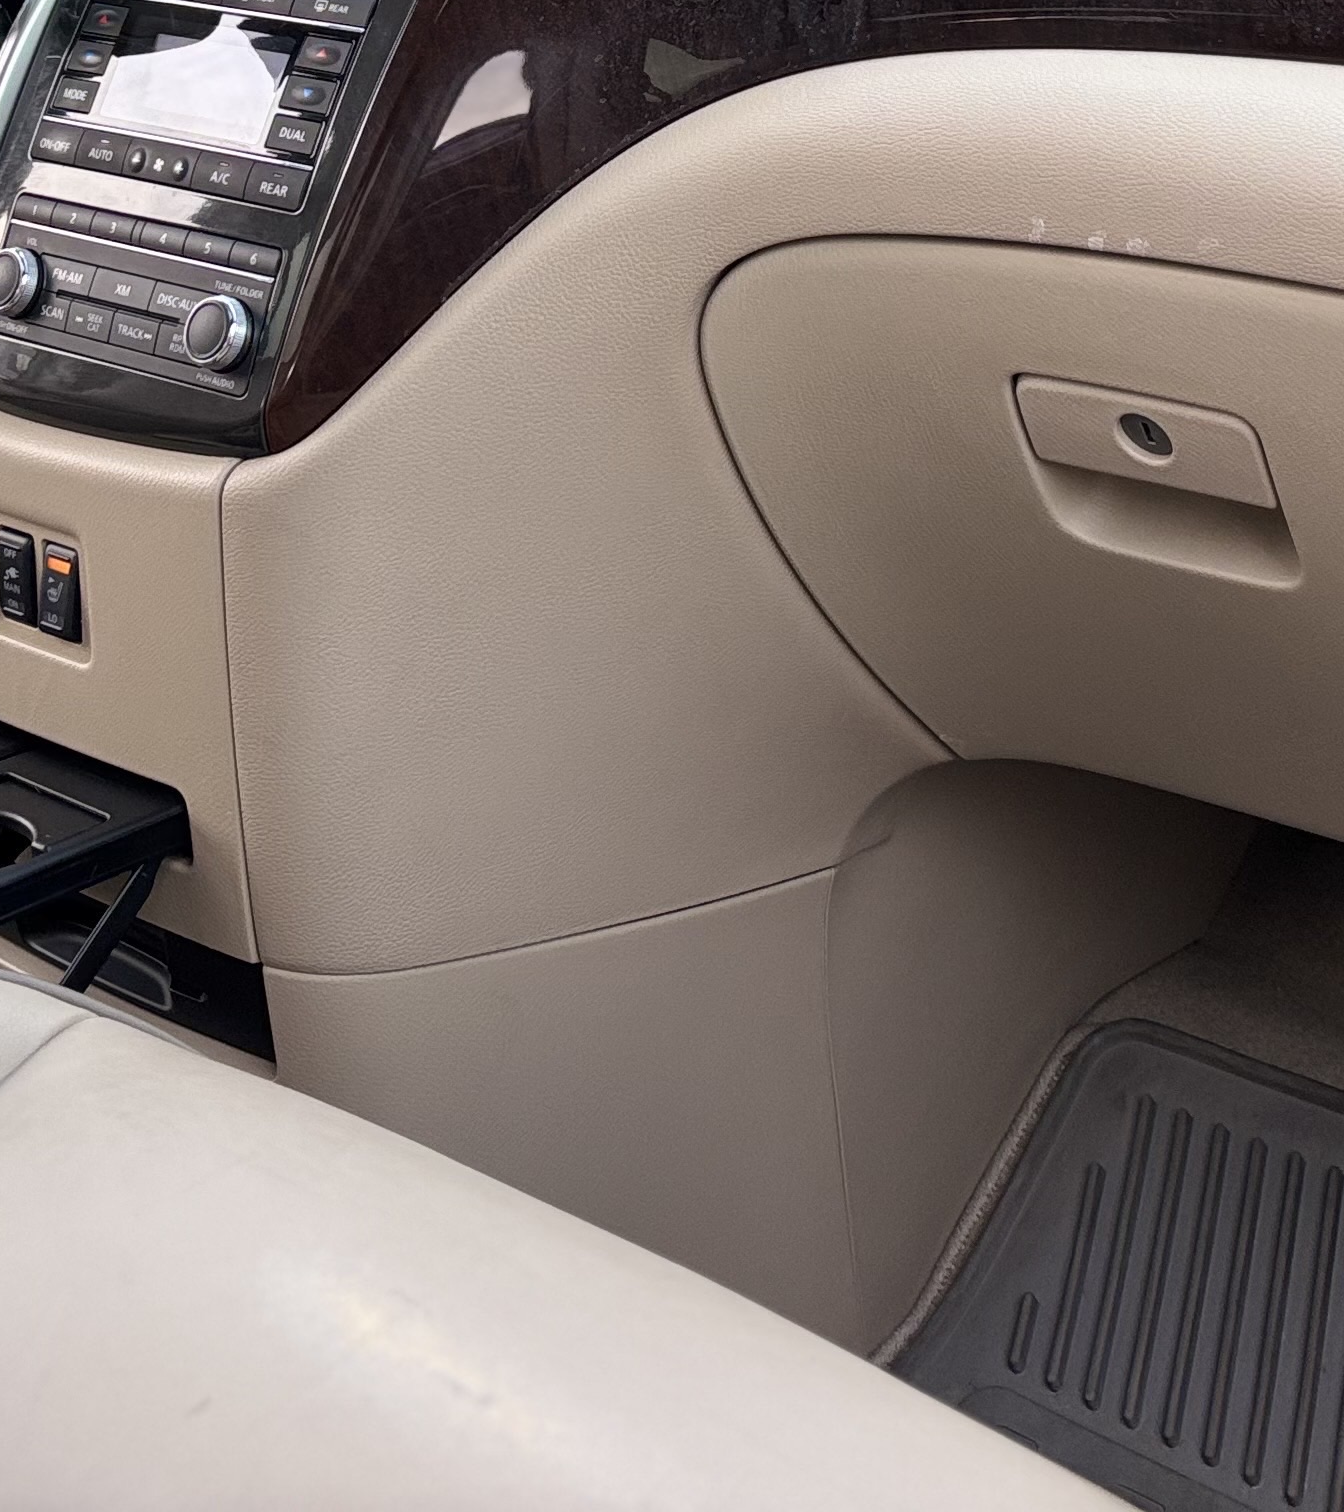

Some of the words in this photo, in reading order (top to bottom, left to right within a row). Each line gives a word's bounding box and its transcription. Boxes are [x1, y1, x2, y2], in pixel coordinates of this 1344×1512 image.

[328, 3, 350, 14] REAR
[62, 87, 89, 102] MODE
[278, 126, 307, 143] DUAL
[88, 147, 114, 162] AUTO
[209, 171, 231, 186] A/C
[259, 181, 289, 198] REAR
[31, 204, 38, 216] 1
[68, 212, 77, 225] 2
[109, 221, 118, 234] 3
[158, 232, 167, 245] 4
[203, 242, 212, 255] 5
[248, 252, 258, 266] 6
[113, 282, 132, 297] XM
[214, 279, 264, 300] TUNE/FOLDER
[40, 304, 65, 321] SCAN
[87, 312, 104, 325] SEEK
[86, 322, 101, 333] CAT
[118, 323, 143, 341] TRACK
[172, 333, 184, 343] RP
[210, 376, 236, 390] AUDIO
[3, 548, 17, 559] OFF
